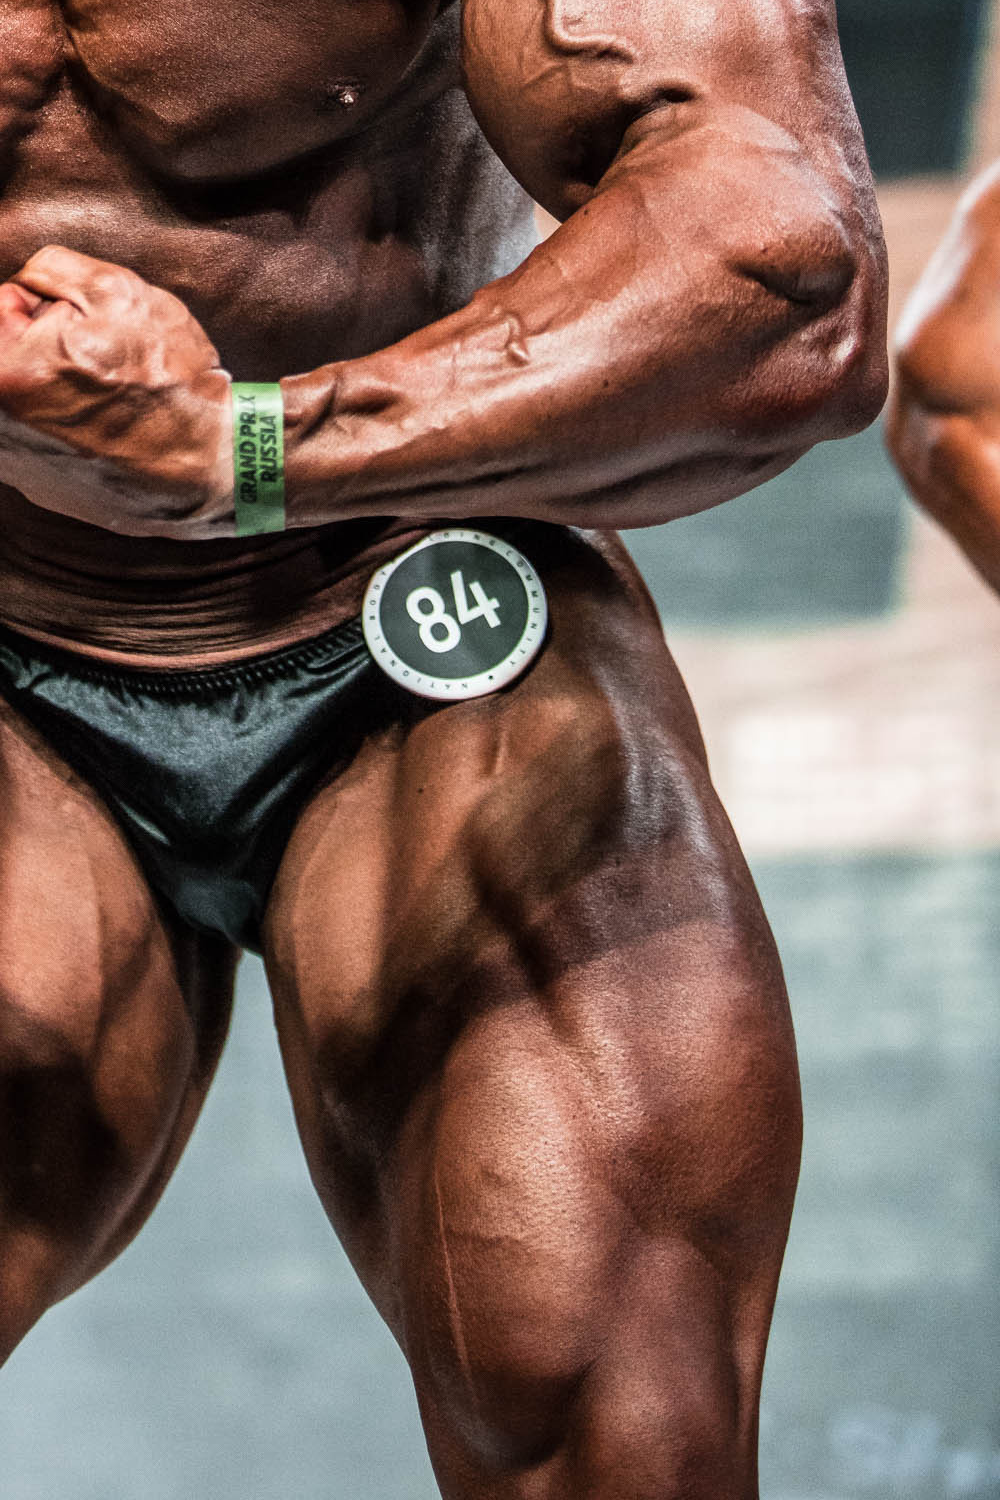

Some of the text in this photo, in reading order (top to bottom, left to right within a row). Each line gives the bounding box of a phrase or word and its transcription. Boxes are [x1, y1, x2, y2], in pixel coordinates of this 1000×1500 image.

[238, 394, 257, 504] GRAND PRIX
[259, 415, 278, 484] RUSSIA
[374, 635, 469, 690] NATIONAL
[505, 549, 541, 667] COMMUNITY
[406, 569, 501, 654] 84
